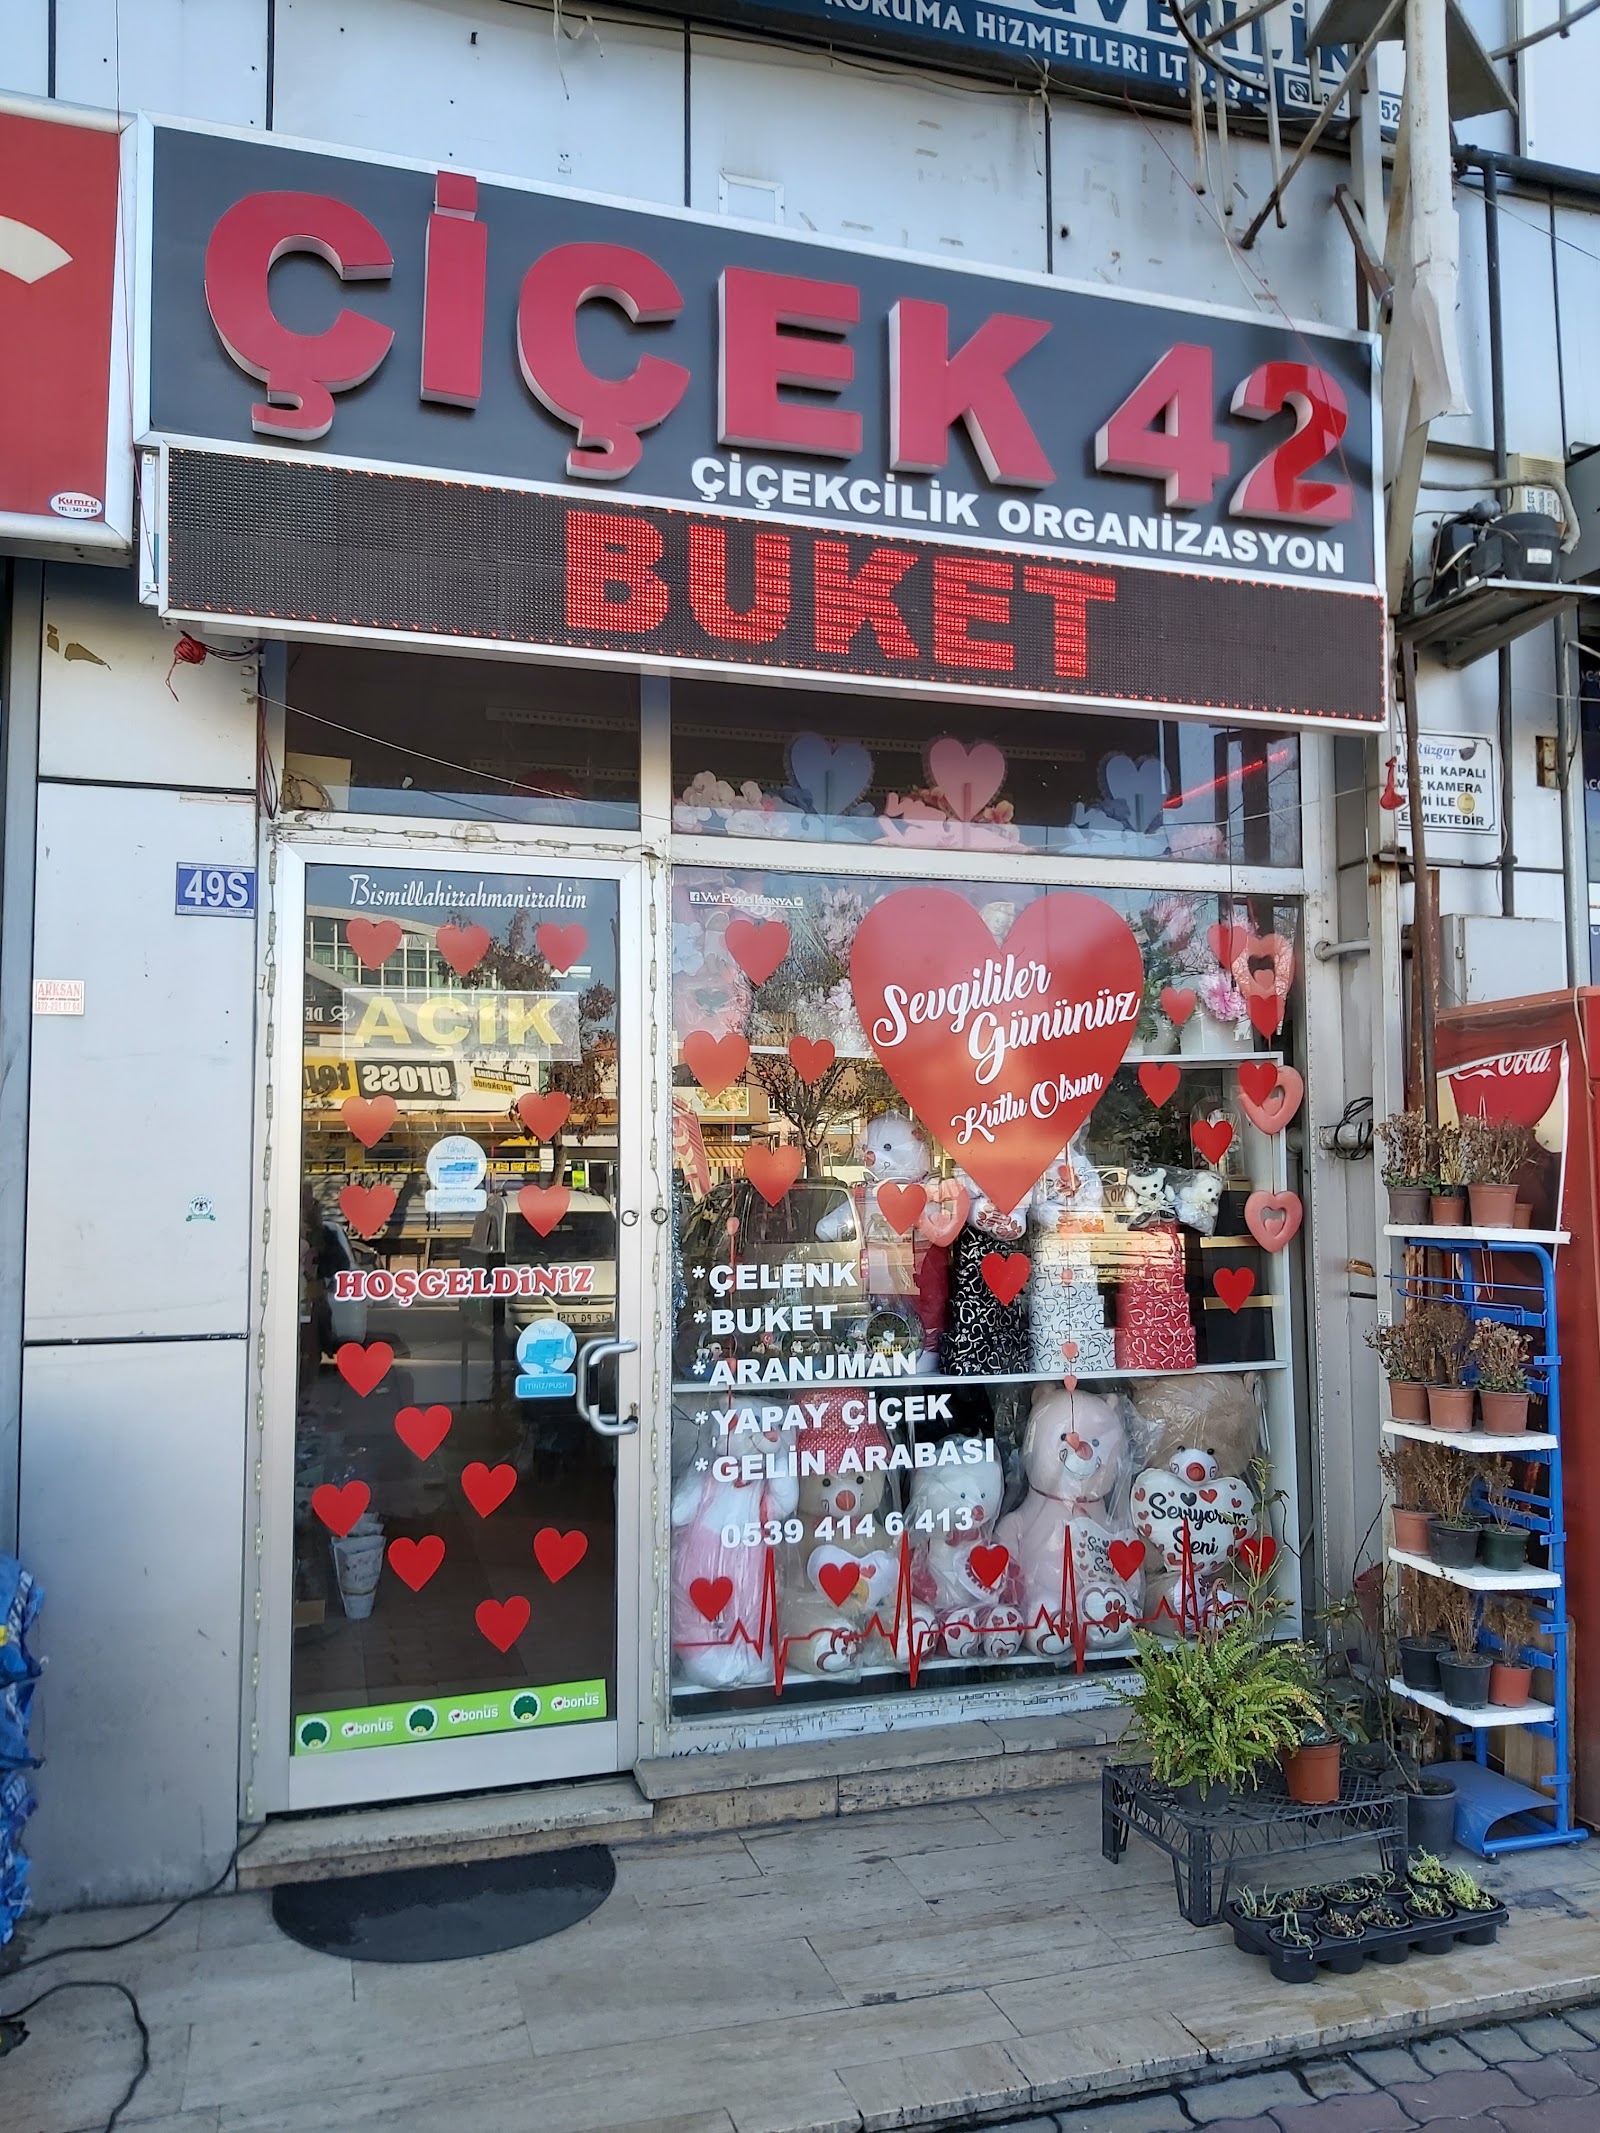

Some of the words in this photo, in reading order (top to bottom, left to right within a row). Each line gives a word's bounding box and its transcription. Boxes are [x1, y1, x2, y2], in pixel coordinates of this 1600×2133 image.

[205, 170, 1056, 488] ÇİÇEK
[1095, 343, 1352, 526] 42
[58, 497, 98, 507] Kumru
[691, 452, 979, 527] ÇİÇEKCİLİK
[998, 499, 1344, 573] ORGANİZASYON
[566, 510, 1117, 678] BUKET
[1427, 780, 1482, 794] KAMERA
[1440, 766, 1486, 779] KAPALI
[1436, 793, 1456, 807] İLE
[184, 870, 249, 908] 49S
[38, 983, 80, 996] ARKSAN
[873, 954, 1051, 1046] Sevgililer
[351, 996, 563, 1057] AÇIK
[969, 989, 1140, 1085] Gününüz
[951, 1092, 1027, 1145] Kutlu
[1030, 1072, 1103, 1119] Olsun
[841, 1391, 953, 1432] ÇİÇEK
[837, 1438, 995, 1474] ARABASI
[721, 1518, 804, 1548] 0539
[814, 1514, 875, 1541] 414
[885, 1510, 904, 1535] 6
[916, 1507, 974, 1534] 413
[461, 1704, 499, 1722] bonus
[563, 1692, 600, 1709] bonus
[354, 1717, 394, 1735] bonus
